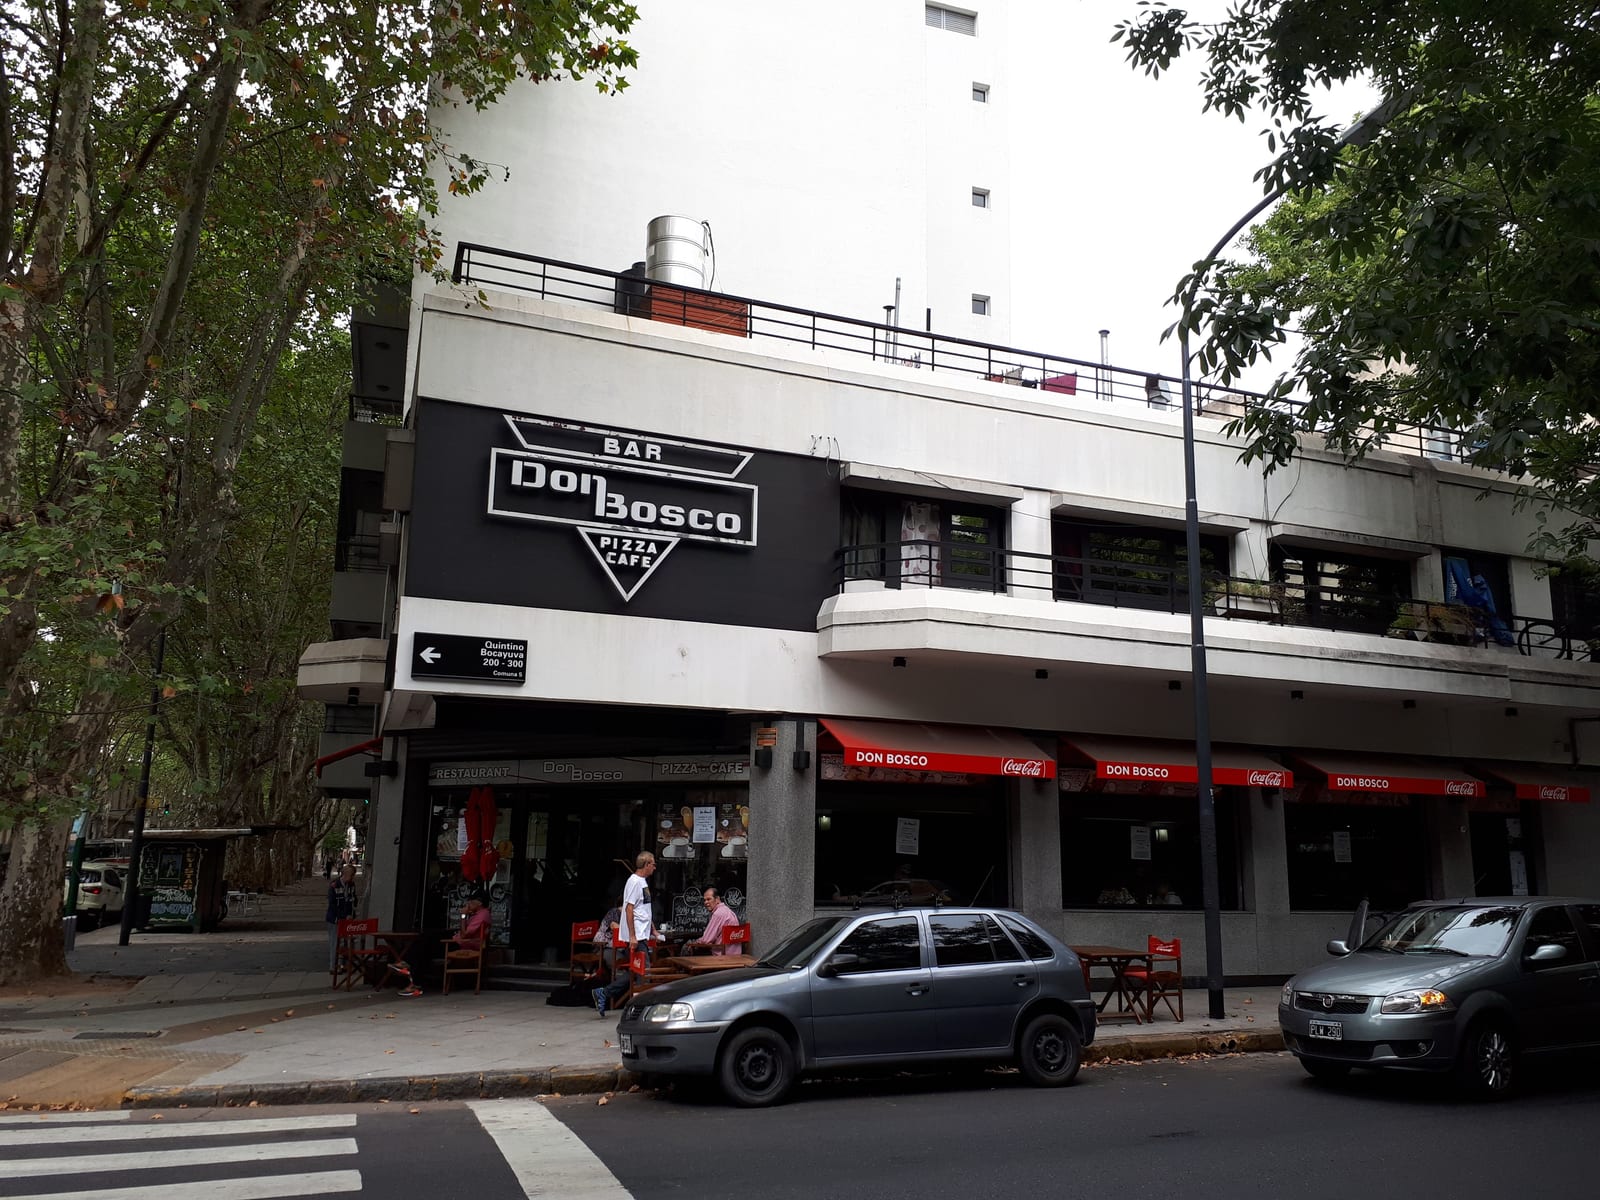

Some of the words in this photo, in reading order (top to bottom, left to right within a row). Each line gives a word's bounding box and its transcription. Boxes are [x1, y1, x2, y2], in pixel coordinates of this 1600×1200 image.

[604, 437, 662, 461] BAR
[600, 536, 658, 554] PIZZA
[606, 551, 652, 568] CAFE
[485, 640, 524, 651] Quintino
[480, 648, 524, 659] Bocayuva
[482, 658, 500, 667] 200
[507, 660, 524, 668] 300
[661, 762, 699, 774] PIZZA
[709, 762, 744, 774] CAFE
[856, 751, 883, 763] DON
[886, 753, 928, 766] BOSCO
[1003, 758, 1042, 777] Coca-Cola
[436, 767, 510, 779] RESTAURANT
[1106, 765, 1130, 776] DON
[1132, 766, 1169, 778] BOSCO
[1249, 771, 1282, 786] Coca-Cola
[1337, 777, 1357, 787] DON
[1358, 778, 1389, 789] BOSCO
[1327, 1026, 1341, 1037] 290
